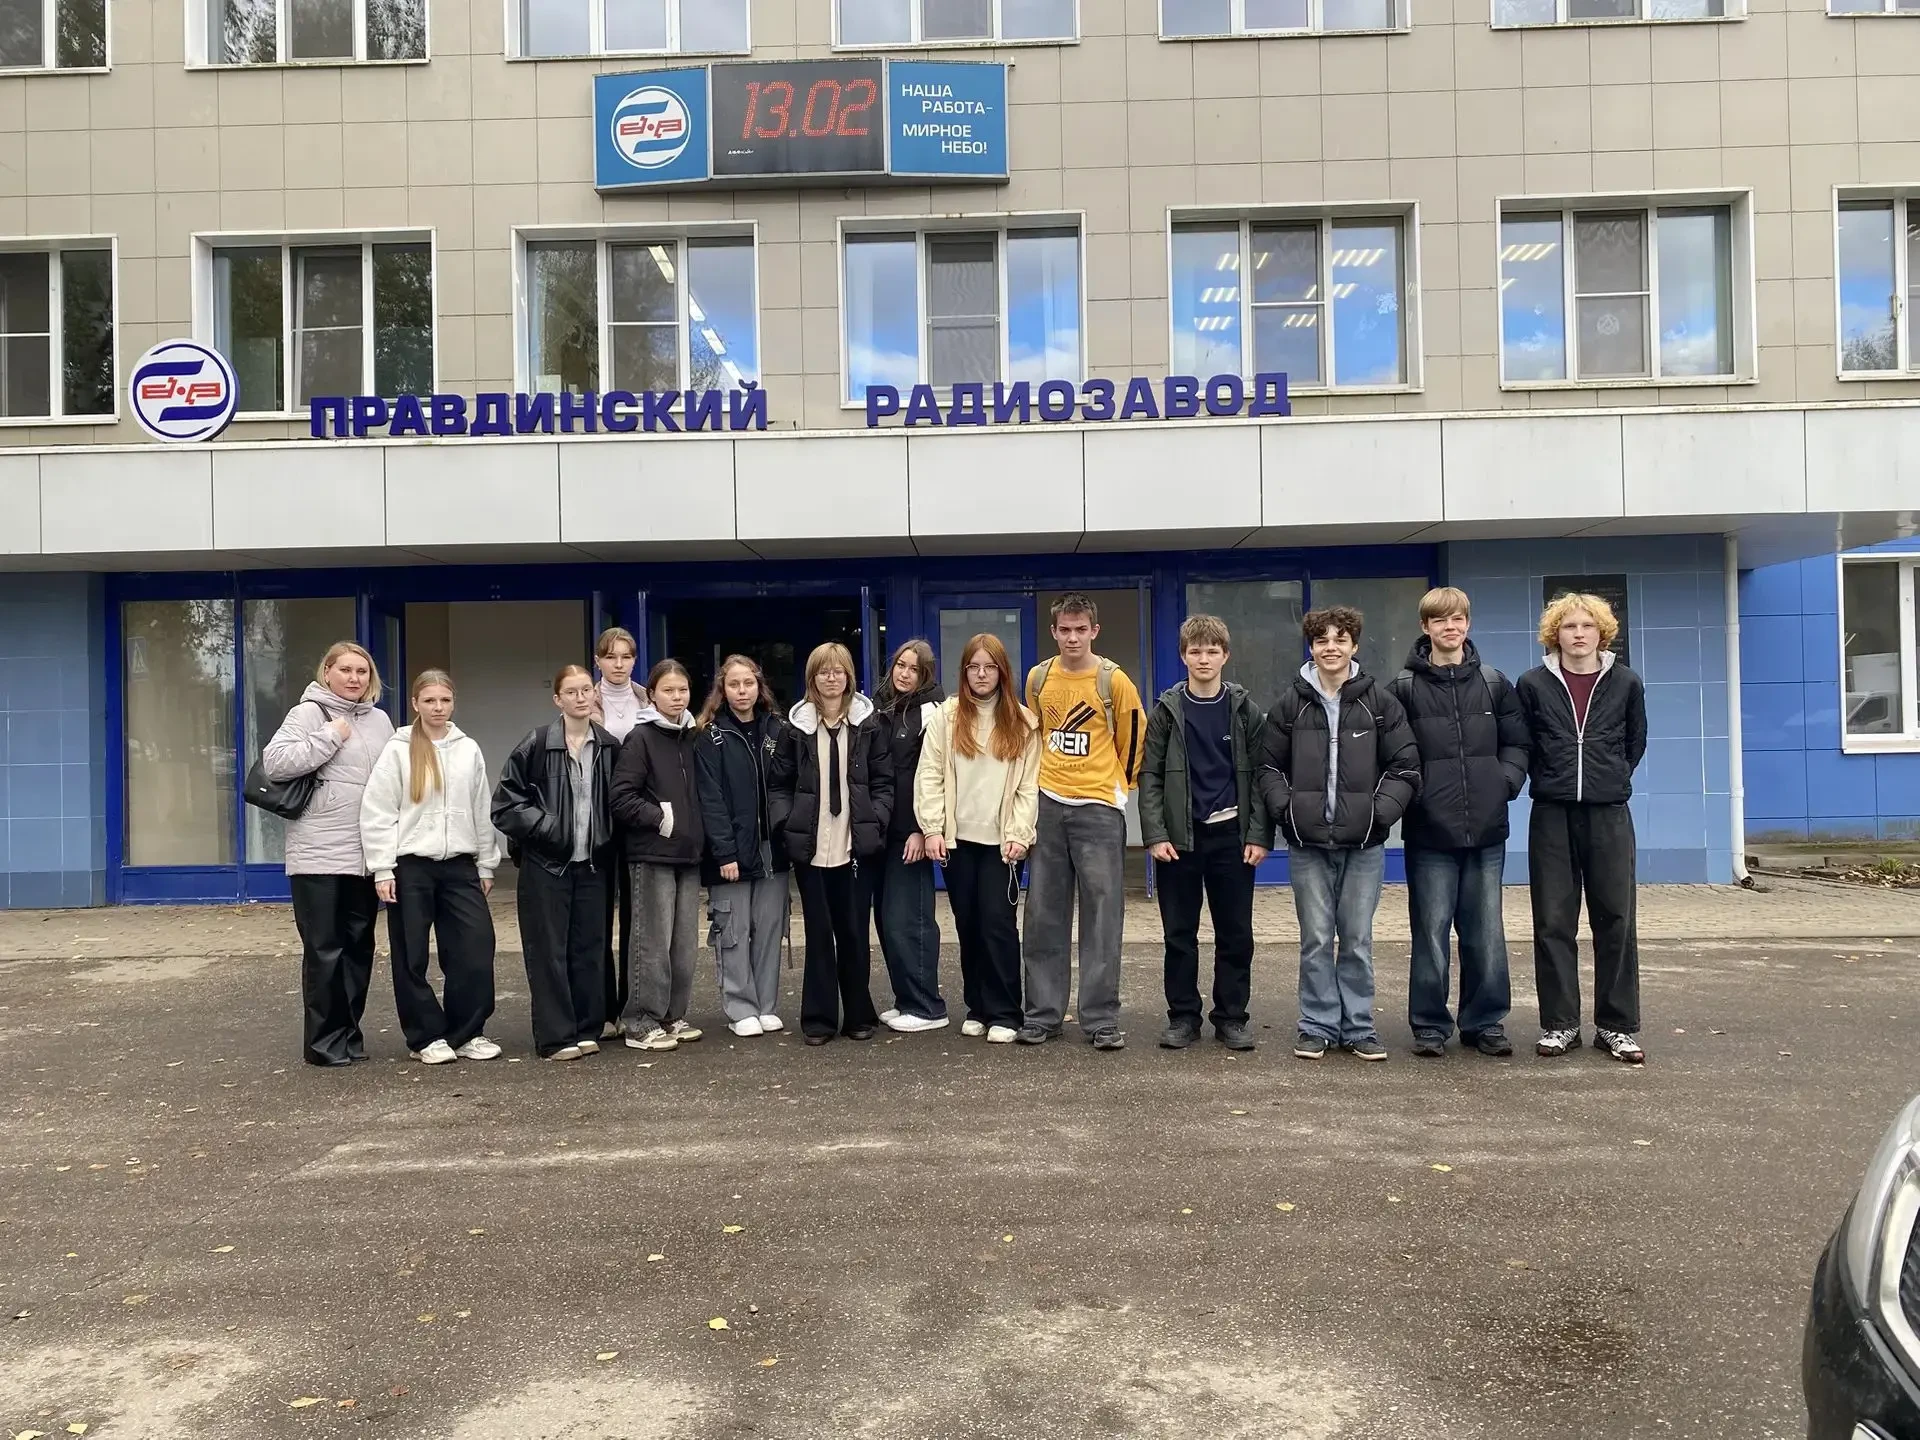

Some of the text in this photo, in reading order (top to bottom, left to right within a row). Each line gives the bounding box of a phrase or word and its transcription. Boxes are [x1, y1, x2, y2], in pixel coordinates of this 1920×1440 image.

[901, 84, 953, 97] НАША
[741, 79, 878, 139] 13.02
[902, 123, 972, 137] МИРНОЕ
[941, 141, 987, 154] НЕБО!
[310, 373, 1291, 438] ПРАВДИНСКИЙ РАДИОЗАВОД
